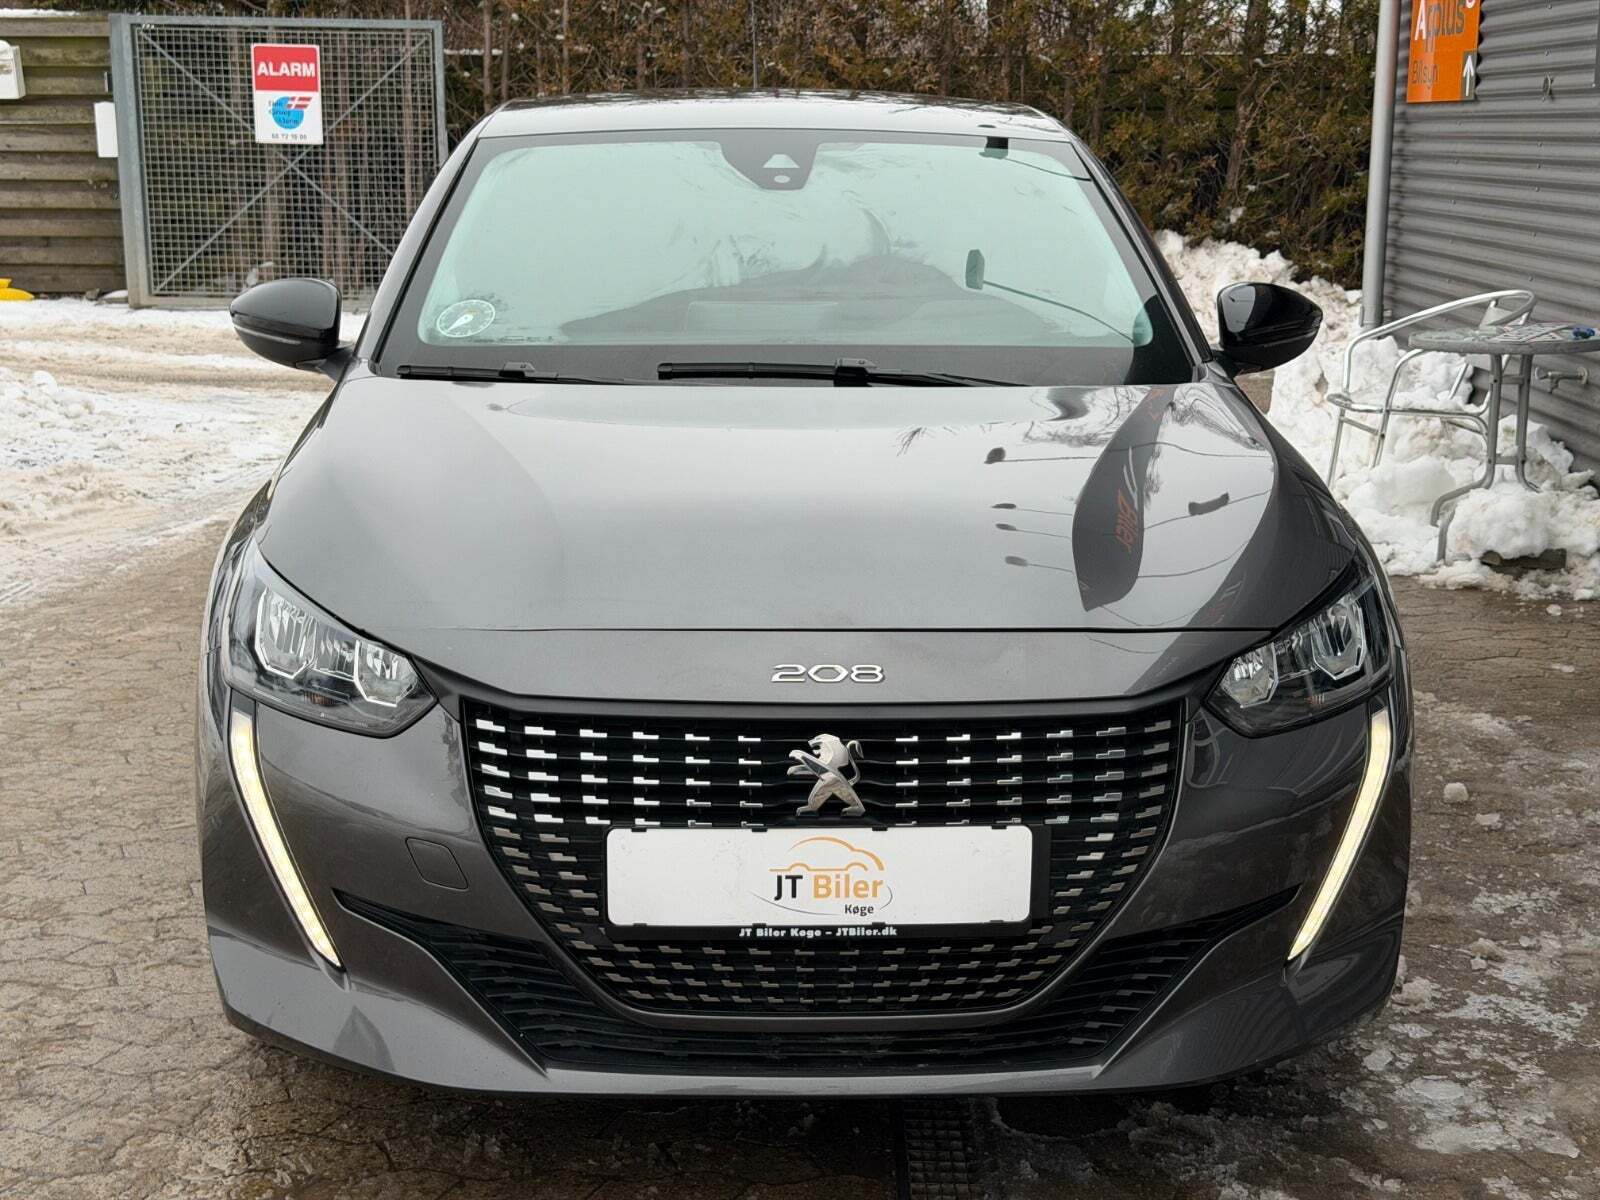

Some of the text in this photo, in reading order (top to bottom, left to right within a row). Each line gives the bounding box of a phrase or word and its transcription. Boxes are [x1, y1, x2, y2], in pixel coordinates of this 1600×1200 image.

[257, 61, 316, 77] ALARM
[771, 664, 884, 682] 208
[774, 874, 884, 901] JT Biler
[844, 904, 875, 916] Køge
[739, 928, 753, 937] JT
[756, 927, 787, 937] Biler
[835, 926, 898, 937] JTBiler.dk
